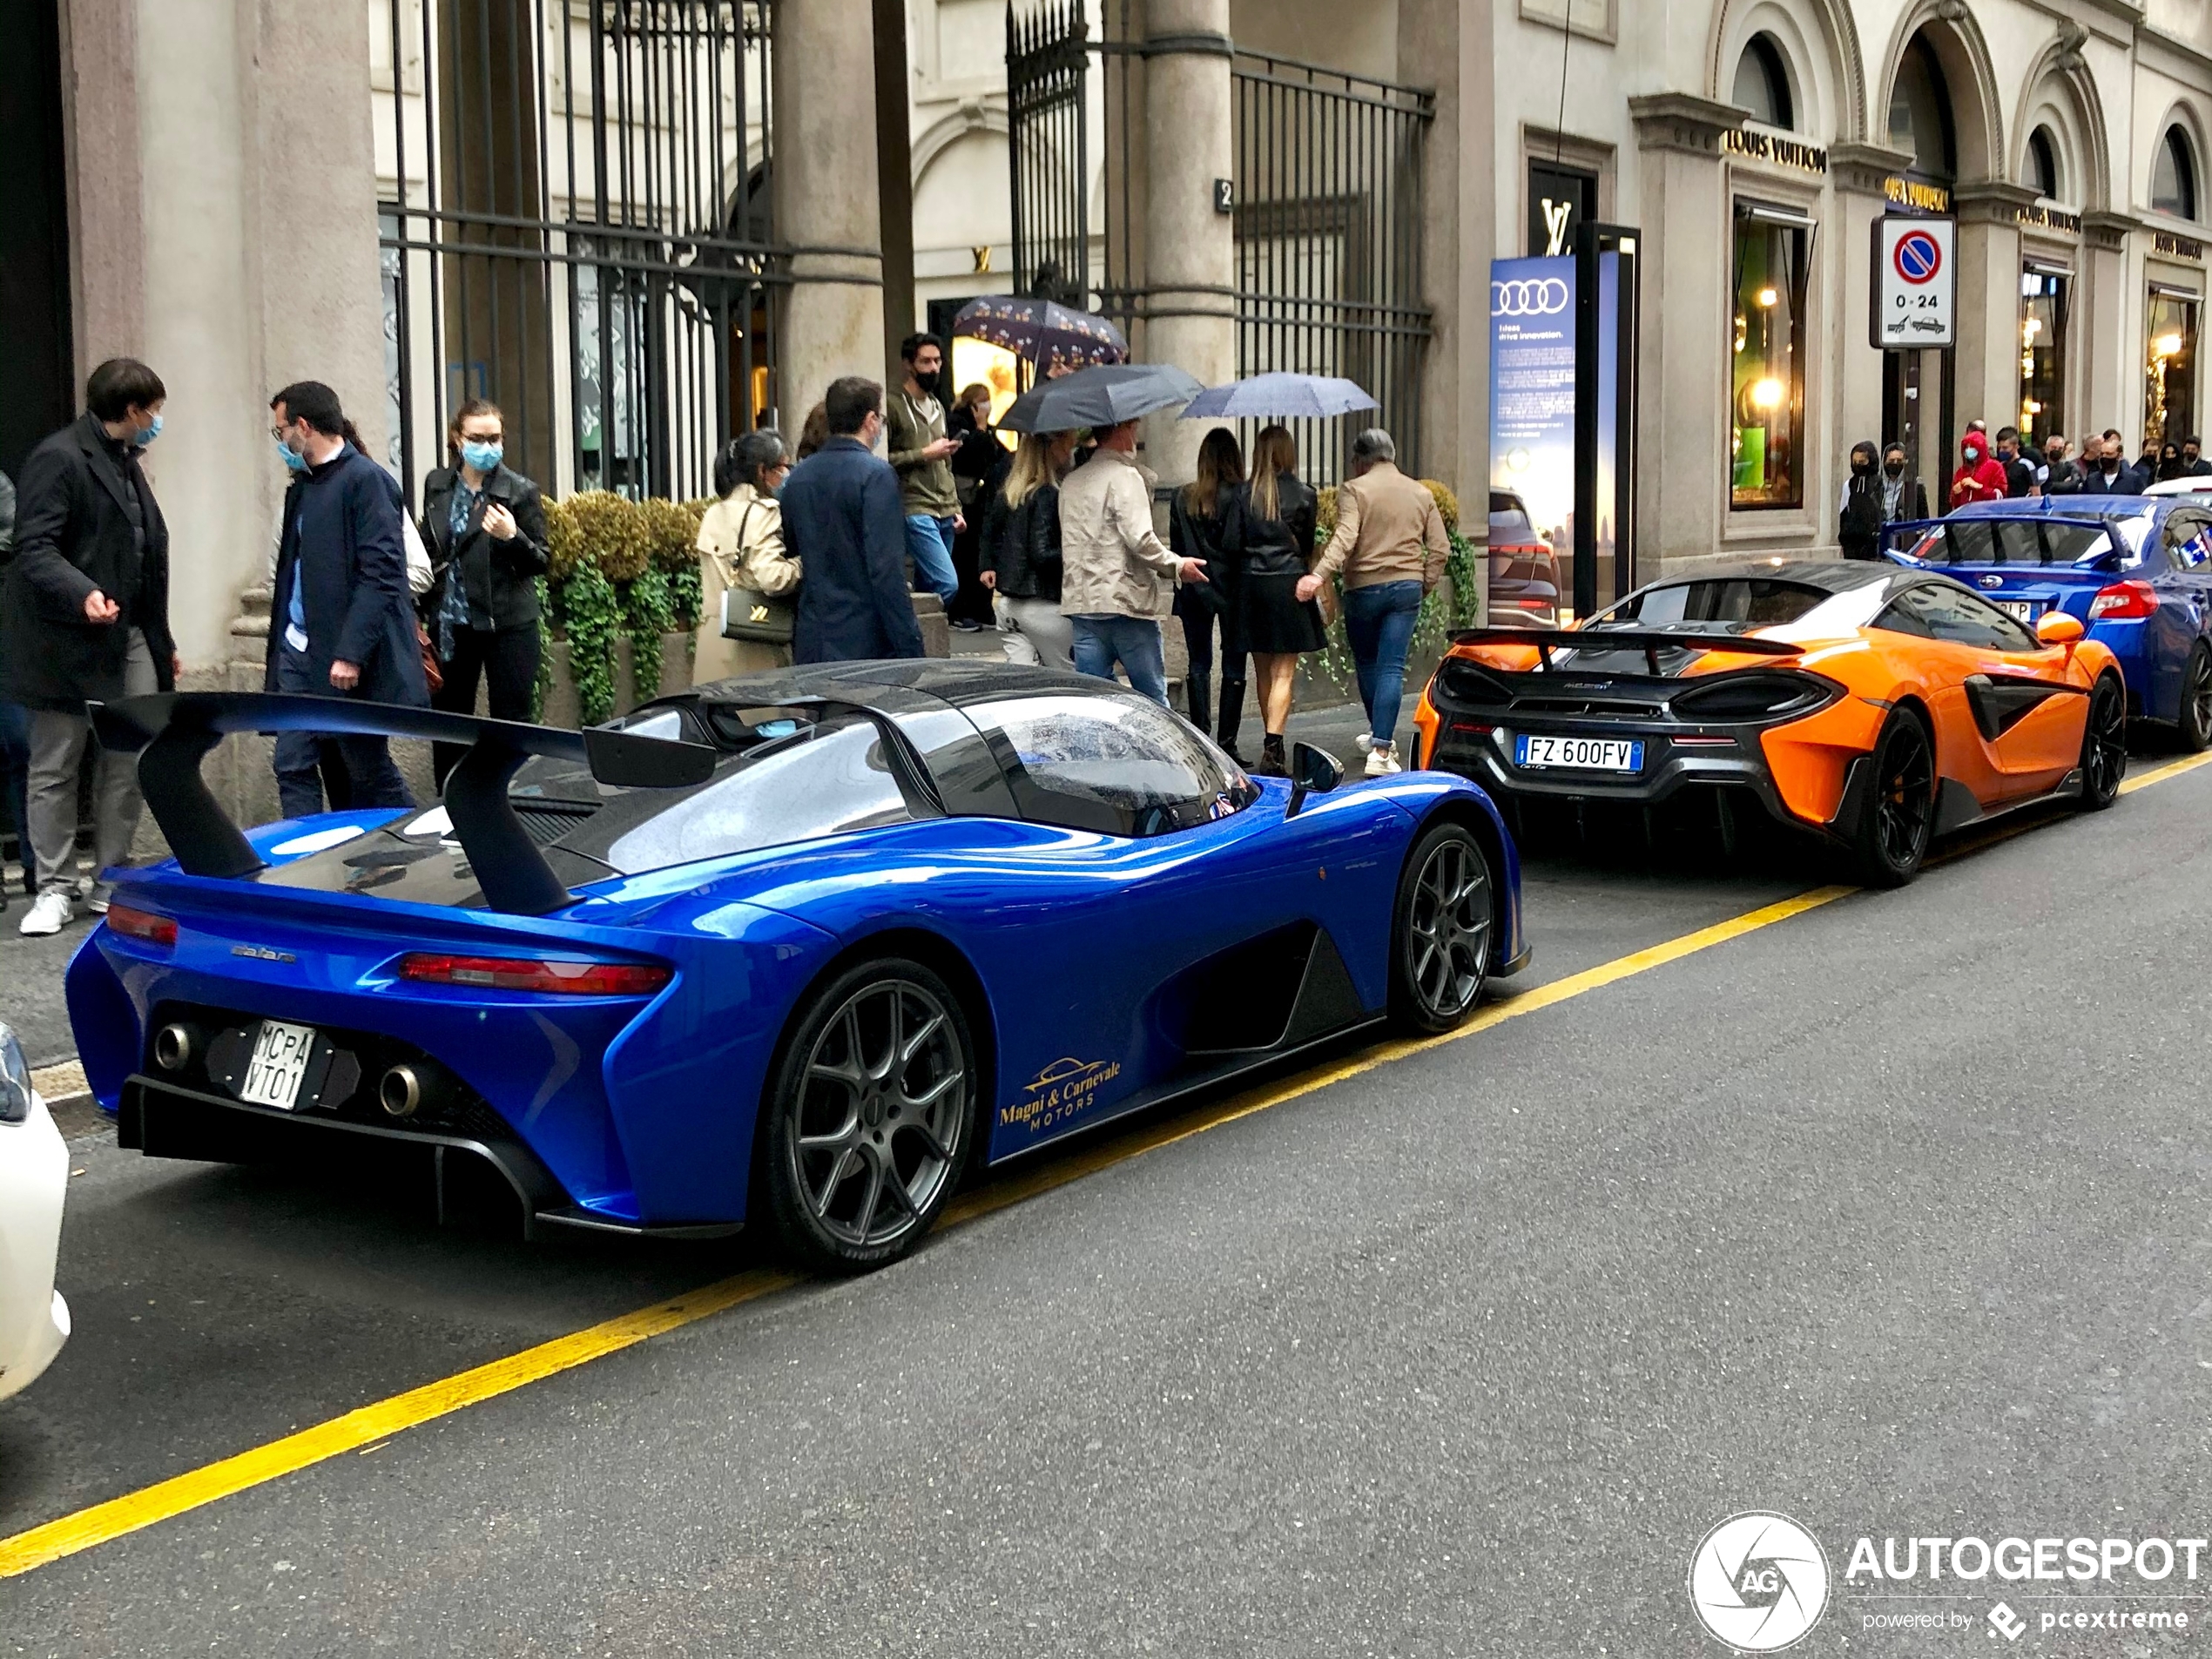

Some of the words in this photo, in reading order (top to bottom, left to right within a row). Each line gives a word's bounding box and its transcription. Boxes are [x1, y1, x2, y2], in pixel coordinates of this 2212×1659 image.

[1724, 130, 1769, 160] LOUIS
[1769, 136, 1826, 174] VUITTON
[1222, 182, 1231, 206] 2
[1896, 294, 1906, 308] 0
[1918, 294, 1939, 308] 24
[1531, 739, 1555, 761] FZ
[1563, 741, 1628, 765] 600FV
[1000, 1094, 1045, 1126] Magni
[1048, 1089, 1060, 1108] &
[1063, 1061, 1121, 1100] Carnevale
[1030, 1092, 1094, 1132] MOTORS
